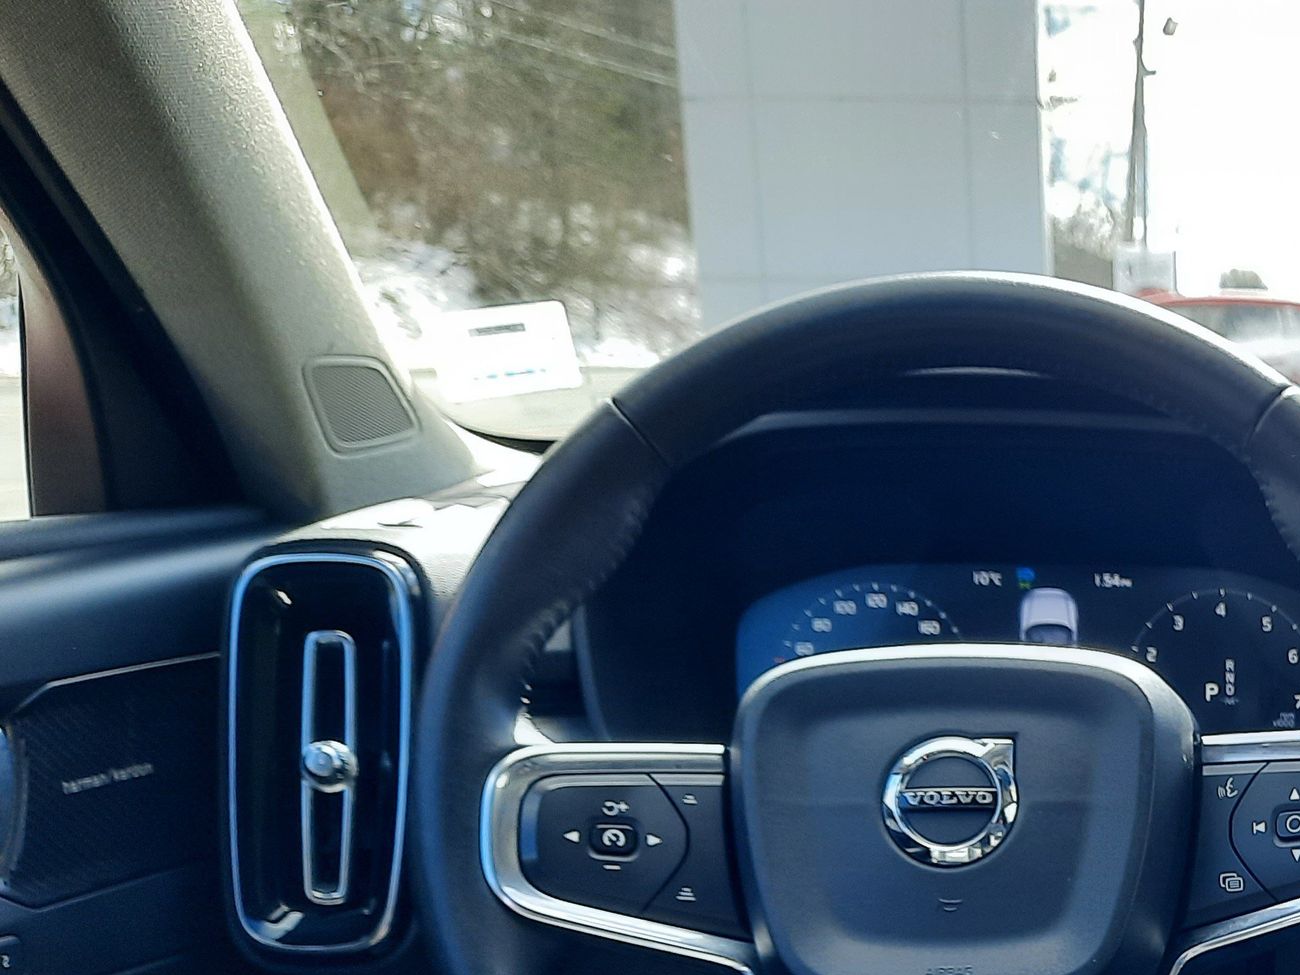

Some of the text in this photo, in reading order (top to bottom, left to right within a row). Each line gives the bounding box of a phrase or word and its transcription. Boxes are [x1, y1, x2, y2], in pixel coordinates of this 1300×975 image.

[1215, 602, 1227, 618] 4
[1173, 614, 1185, 631] 3
[1261, 615, 1273, 632] 5
[1146, 647, 1158, 663] 2
[1288, 648, 1299, 665] 6
[1205, 682, 1219, 702] P
[904, 791, 994, 807] VOLVO
